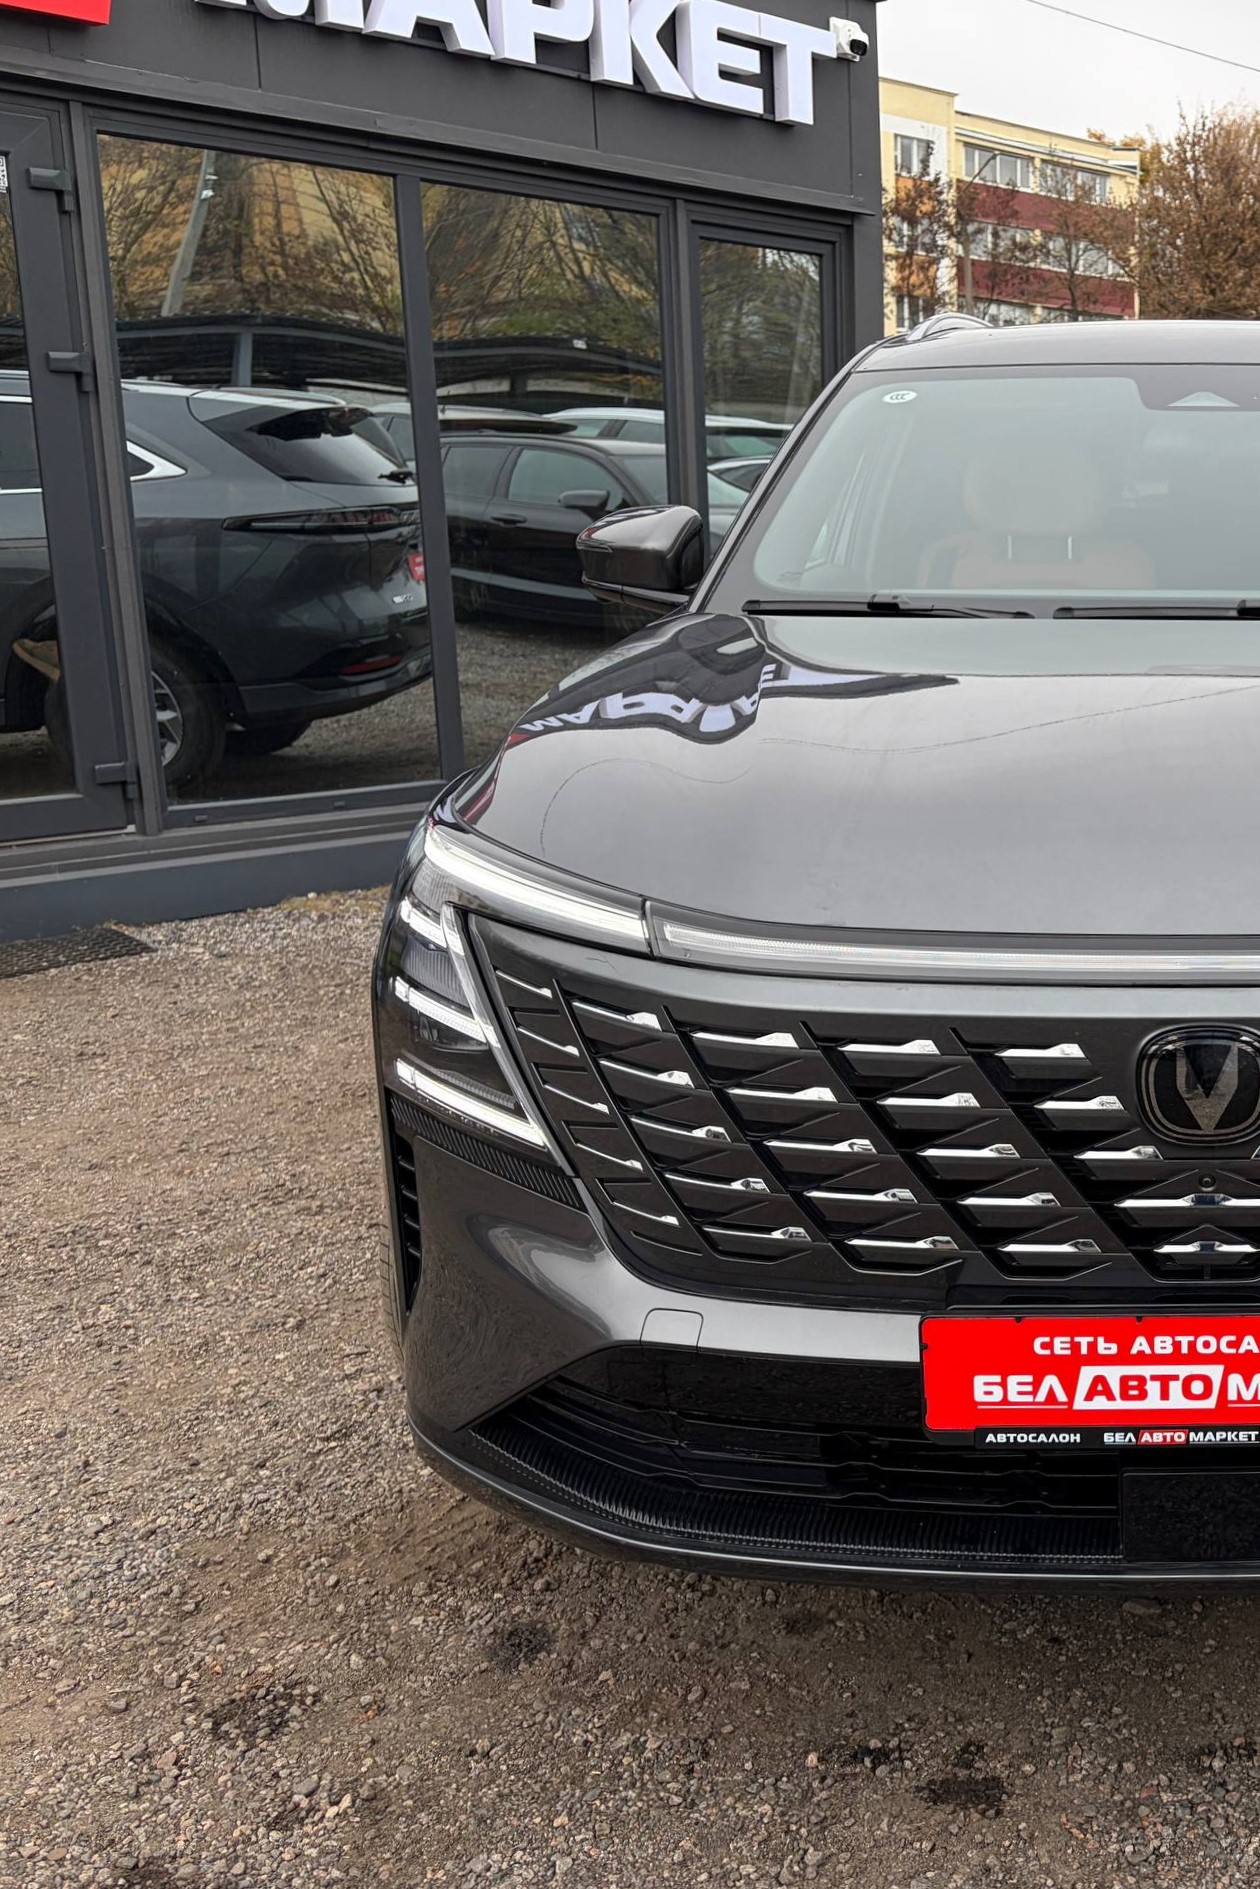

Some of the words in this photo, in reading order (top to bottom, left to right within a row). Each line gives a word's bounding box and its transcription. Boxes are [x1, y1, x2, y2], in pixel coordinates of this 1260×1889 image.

[194, 0, 838, 125] АРКЕТ
[1033, 1336, 1119, 1355] СЕТЬ
[985, 1432, 1081, 1443] АВТОСАЛОН
